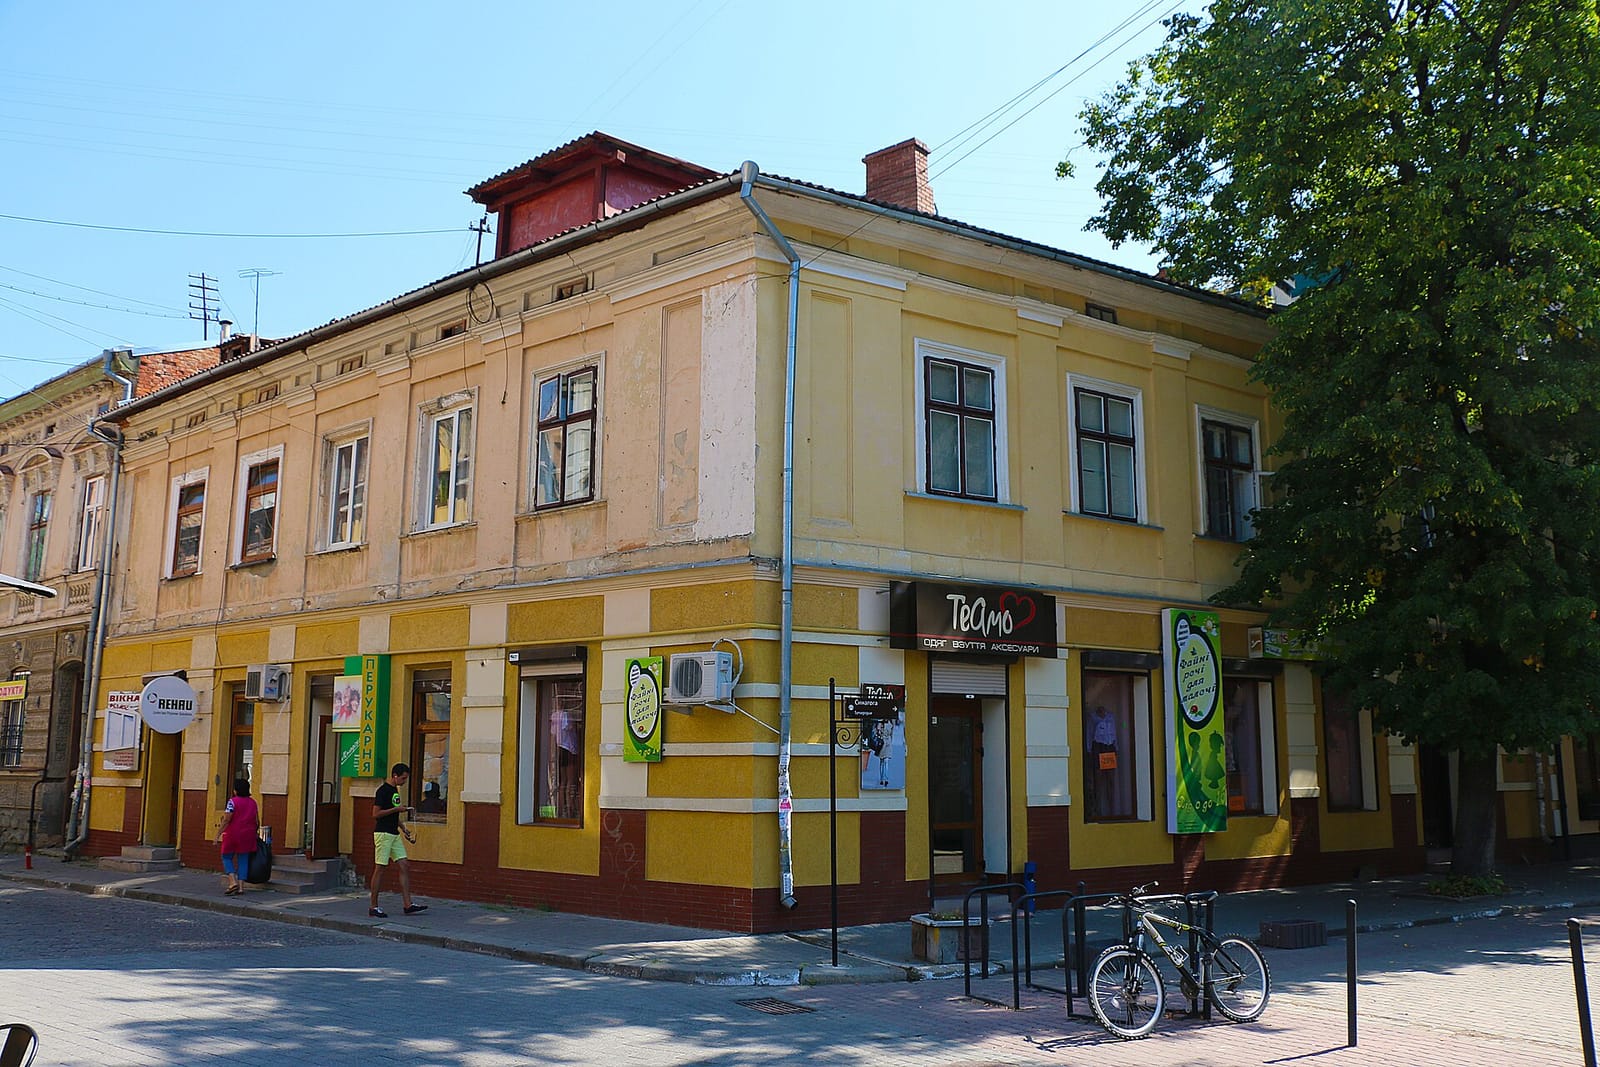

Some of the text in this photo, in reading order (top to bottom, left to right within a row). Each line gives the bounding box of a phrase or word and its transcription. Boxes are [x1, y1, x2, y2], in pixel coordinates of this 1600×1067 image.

[923, 638, 1040, 653] ОДЯГ ВЗУТТЯ АКСЕСУАРИ
[1180, 652, 1210, 669] Файні
[1186, 677, 1204, 692] для
[158, 699, 192, 710] REHAU
[362, 658, 375, 773] ПЕРУКАРНЯ
